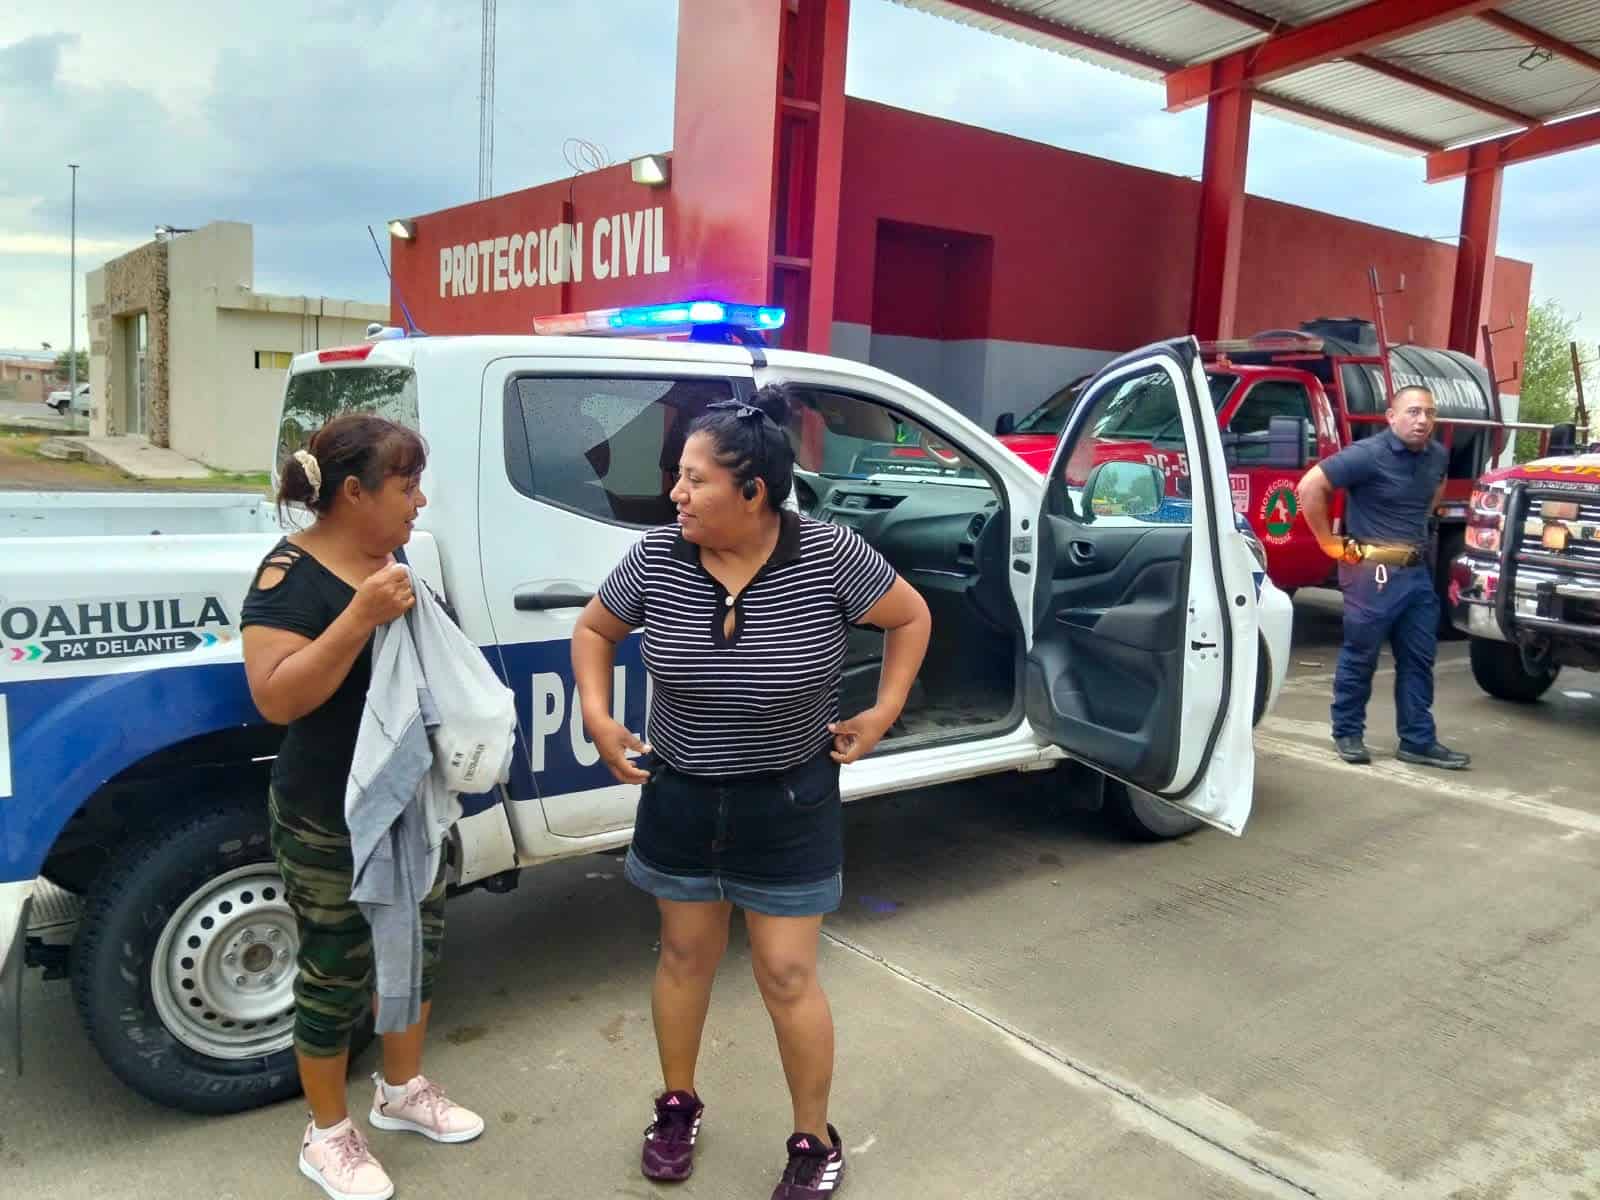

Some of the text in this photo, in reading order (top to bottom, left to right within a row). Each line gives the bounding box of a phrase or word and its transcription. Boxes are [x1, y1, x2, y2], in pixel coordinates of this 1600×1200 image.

[440, 207, 670, 298] PROTECCION CIVIL
[95, 635, 186, 656] DELANTE
